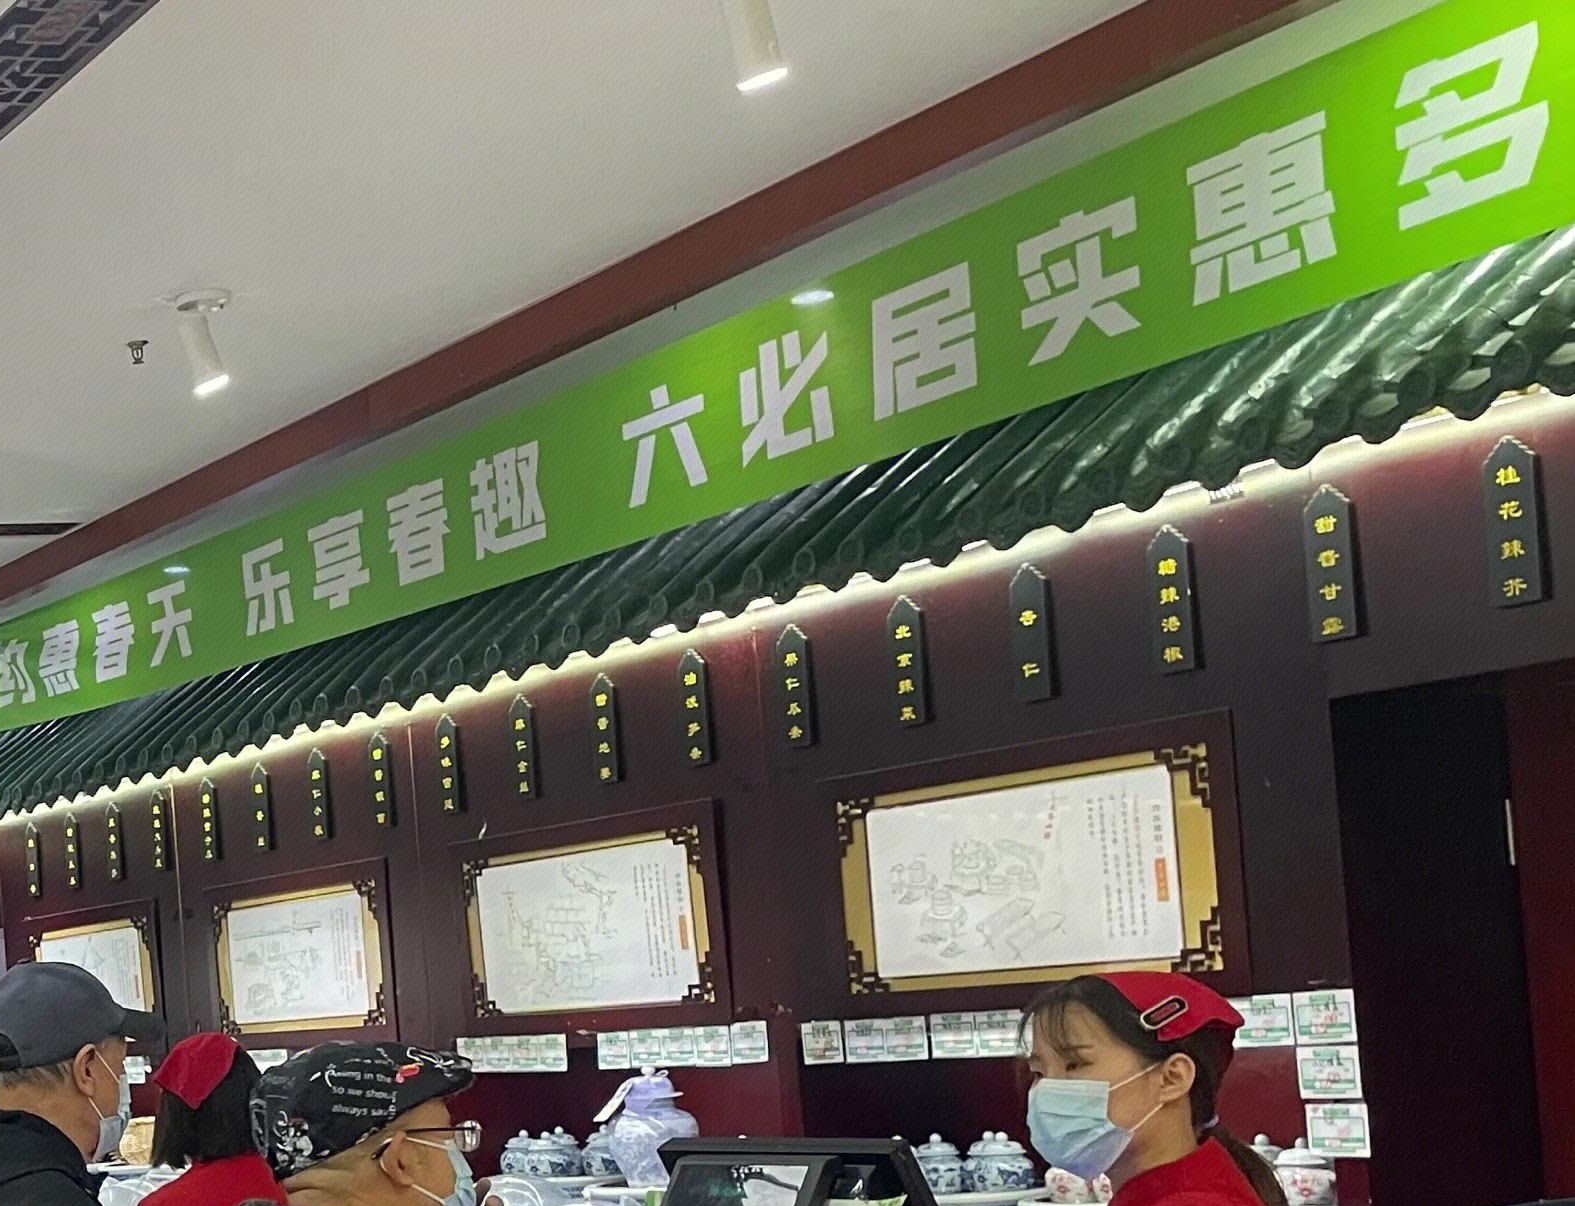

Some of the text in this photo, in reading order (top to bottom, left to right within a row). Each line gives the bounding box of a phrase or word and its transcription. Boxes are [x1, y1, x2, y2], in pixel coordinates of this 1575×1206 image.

[241, 440, 547, 637] 乐享春趣
[620, 19, 1550, 508] 六必居实惠多
